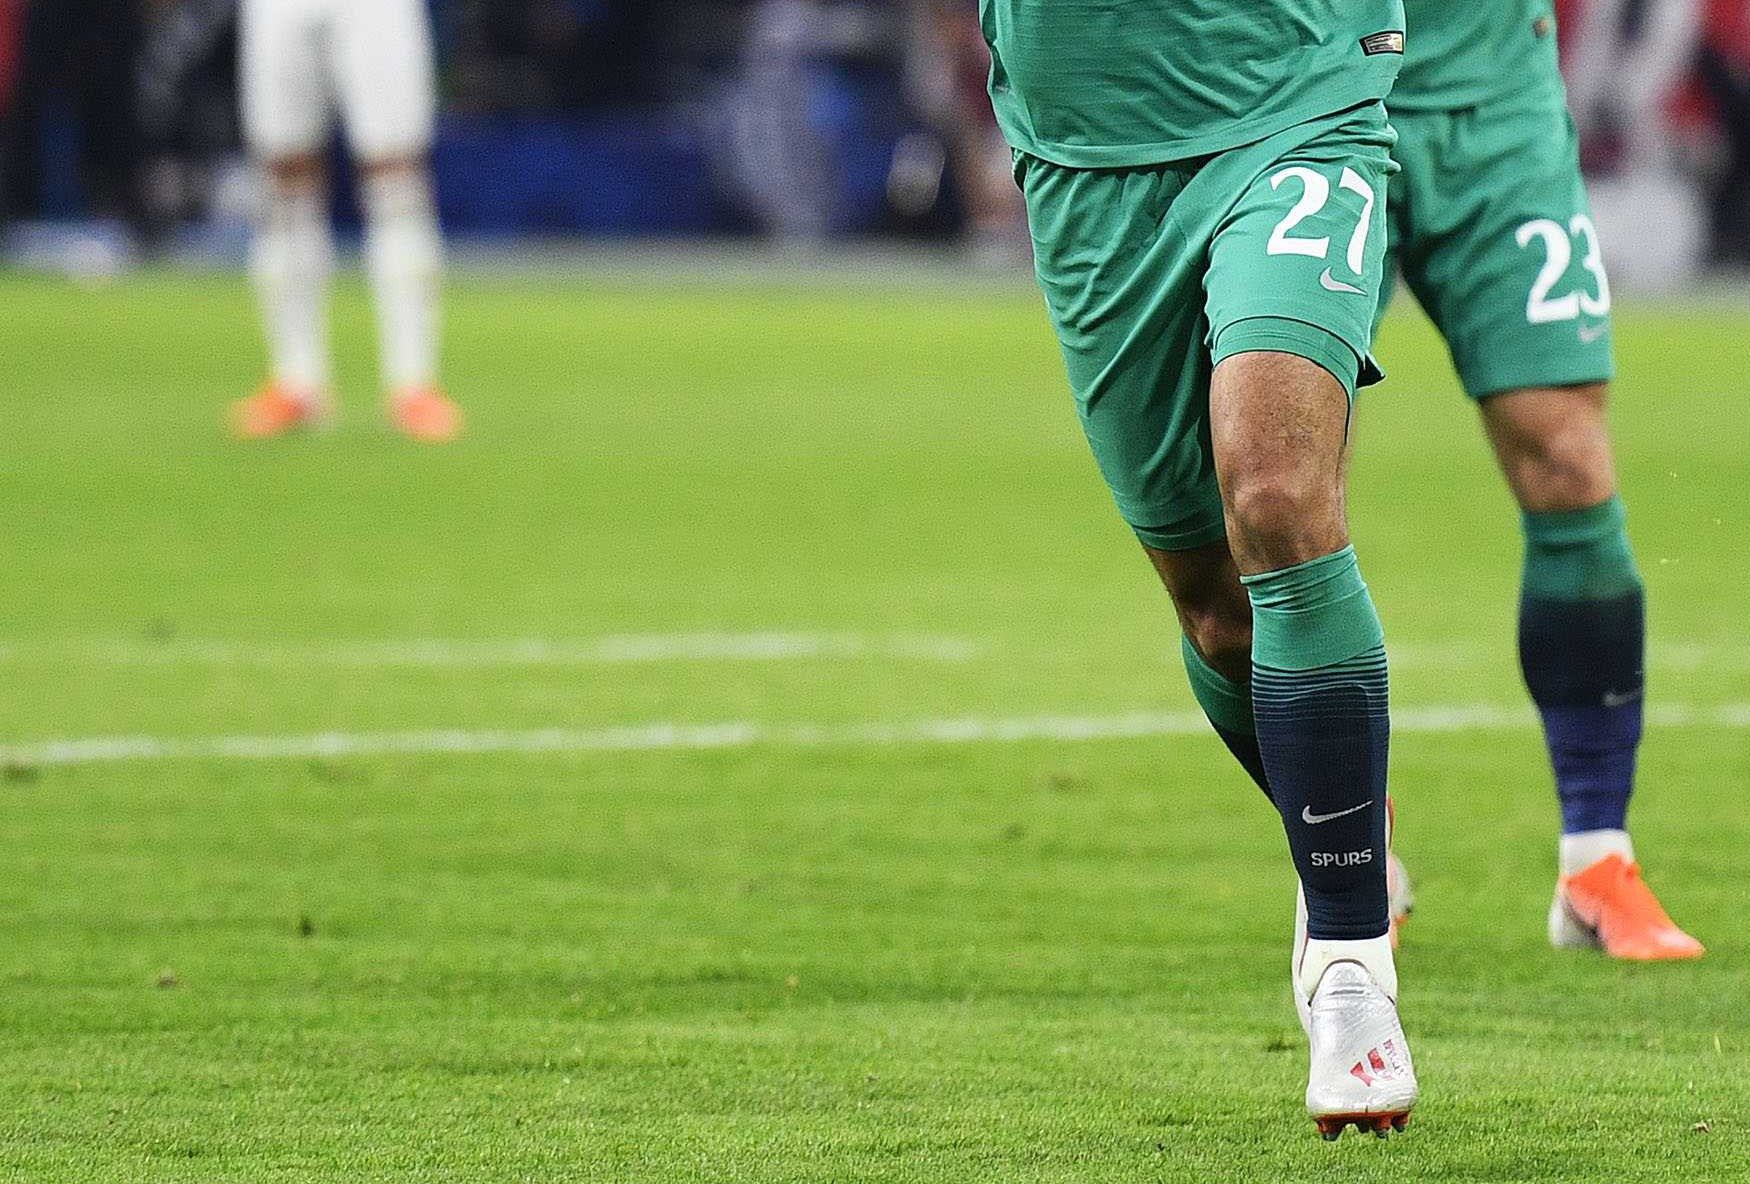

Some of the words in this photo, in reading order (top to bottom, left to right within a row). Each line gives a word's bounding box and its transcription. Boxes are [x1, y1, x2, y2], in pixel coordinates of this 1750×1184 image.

[1266, 166, 1374, 275] 27
[1515, 213, 1610, 323] 23
[1311, 848, 1372, 866] SPURS
